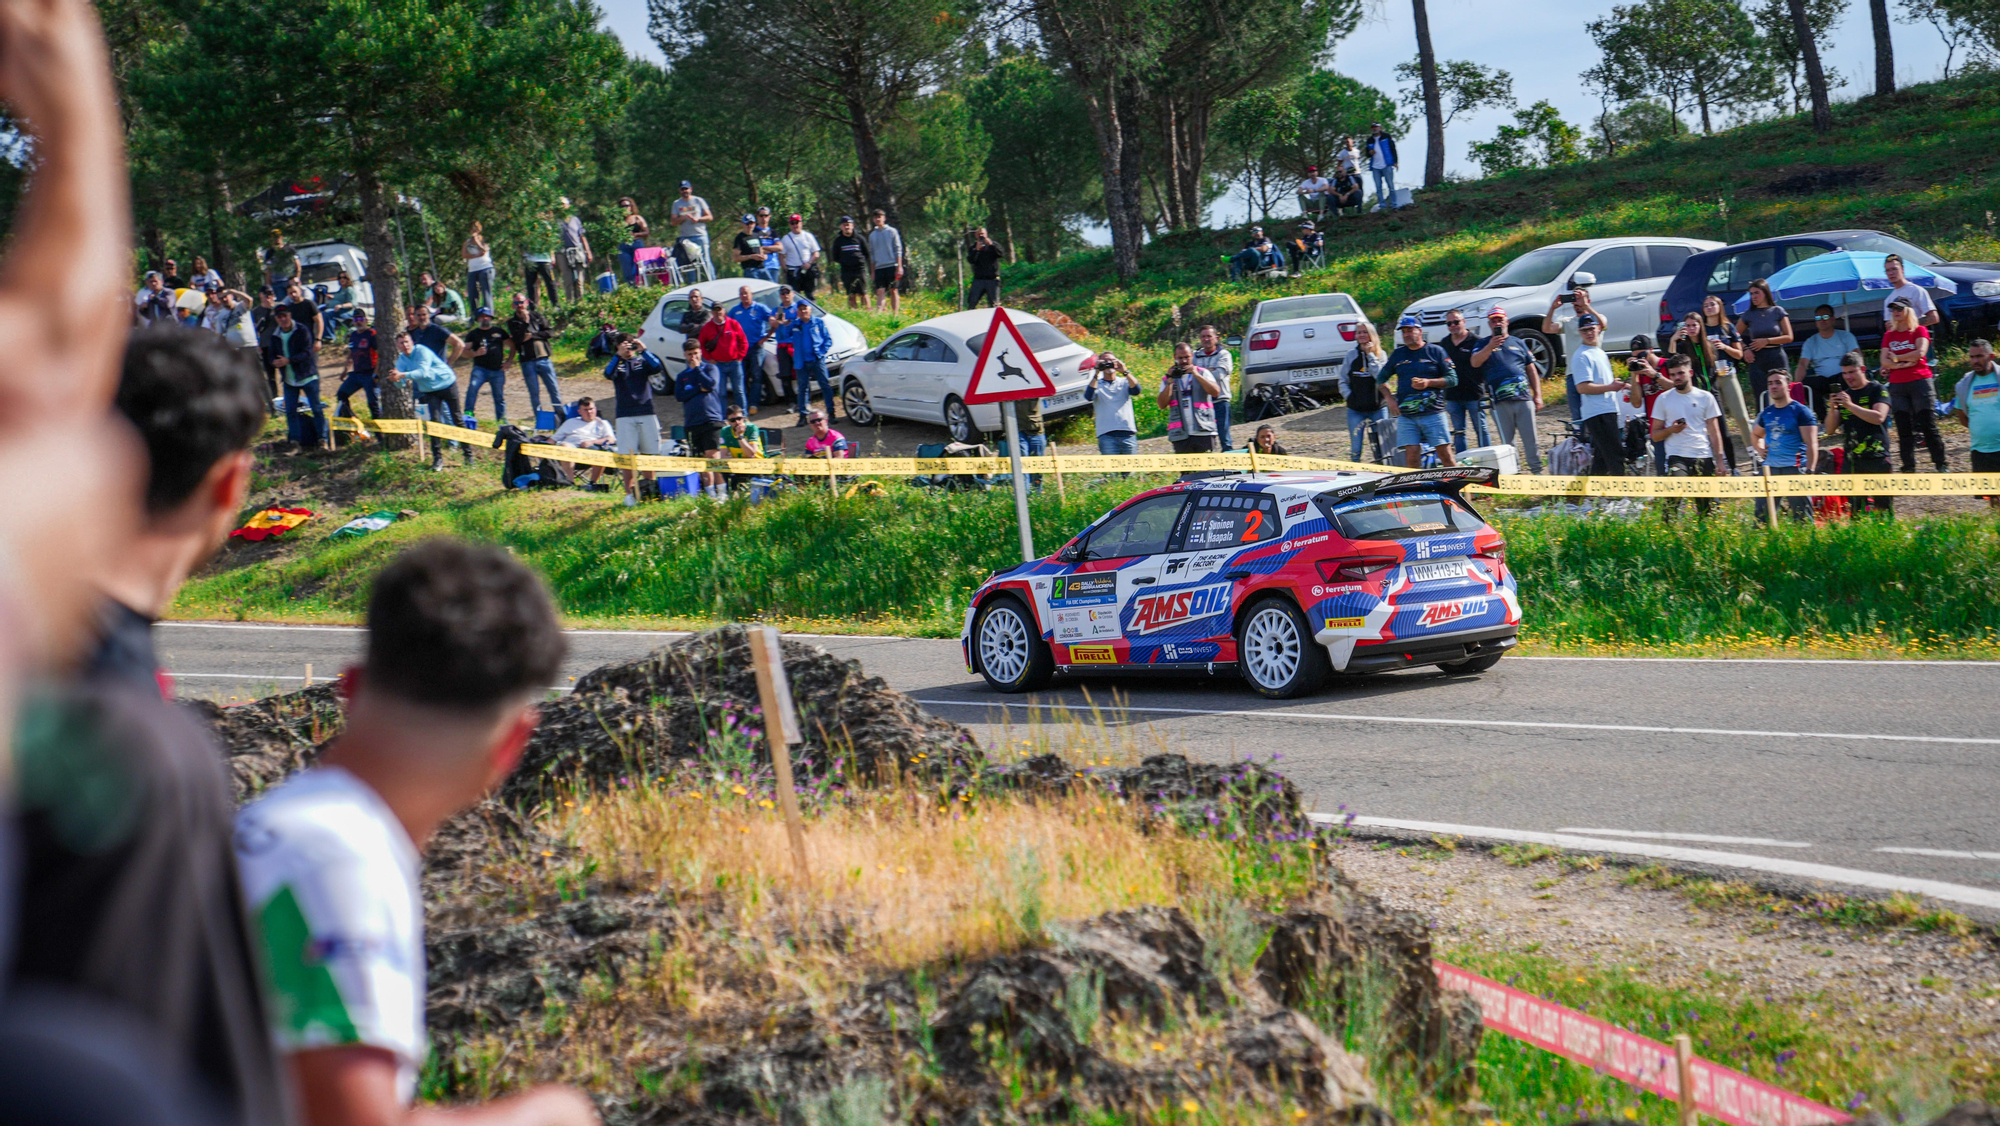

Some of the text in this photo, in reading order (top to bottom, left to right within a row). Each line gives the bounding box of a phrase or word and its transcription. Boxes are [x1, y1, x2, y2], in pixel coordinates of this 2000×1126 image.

[870, 462, 911, 470] ZONA PUBLICO
[917, 461, 959, 471] ZONA PUBLICO
[1064, 459, 1106, 468] ZONA PUBLICO
[1110, 458, 1152, 468] ZONA PUBLICO
[1159, 458, 1200, 468] ZONA PUBLICO
[1208, 456, 1252, 466] ZONA PUBLICO
[1258, 456, 1303, 470] ZONA PUBLICO
[1530, 480, 1583, 491] ZONA PUBLICO
[1590, 480, 1646, 492] ZONA PUBLICO
[1654, 481, 1710, 492] ZONA PUBLICO
[1719, 481, 1778, 492] ZONA PUBLICO
[1788, 480, 1854, 491] ZONA PUBLICO
[1864, 479, 1930, 490] ZONA PUBLICO
[1942, 478, 1968, 490] ZONA
[1338, 486, 1363, 497] SKODA
[1202, 520, 1234, 530] T. Suninen
[1240, 510, 1263, 542] 2
[1199, 531, 1234, 544] A. Haapala
[1294, 535, 1328, 548] ferratum
[1414, 562, 1464, 580] WW-119-ZY
[1054, 580, 1064, 598] 2
[1326, 584, 1362, 594] ferratum
[1132, 586, 1228, 631] AMSOIL
[1422, 599, 1487, 625] AMSOIL
[1329, 618, 1362, 628] PIRELLI
[1073, 648, 1112, 660] PIRELLI
